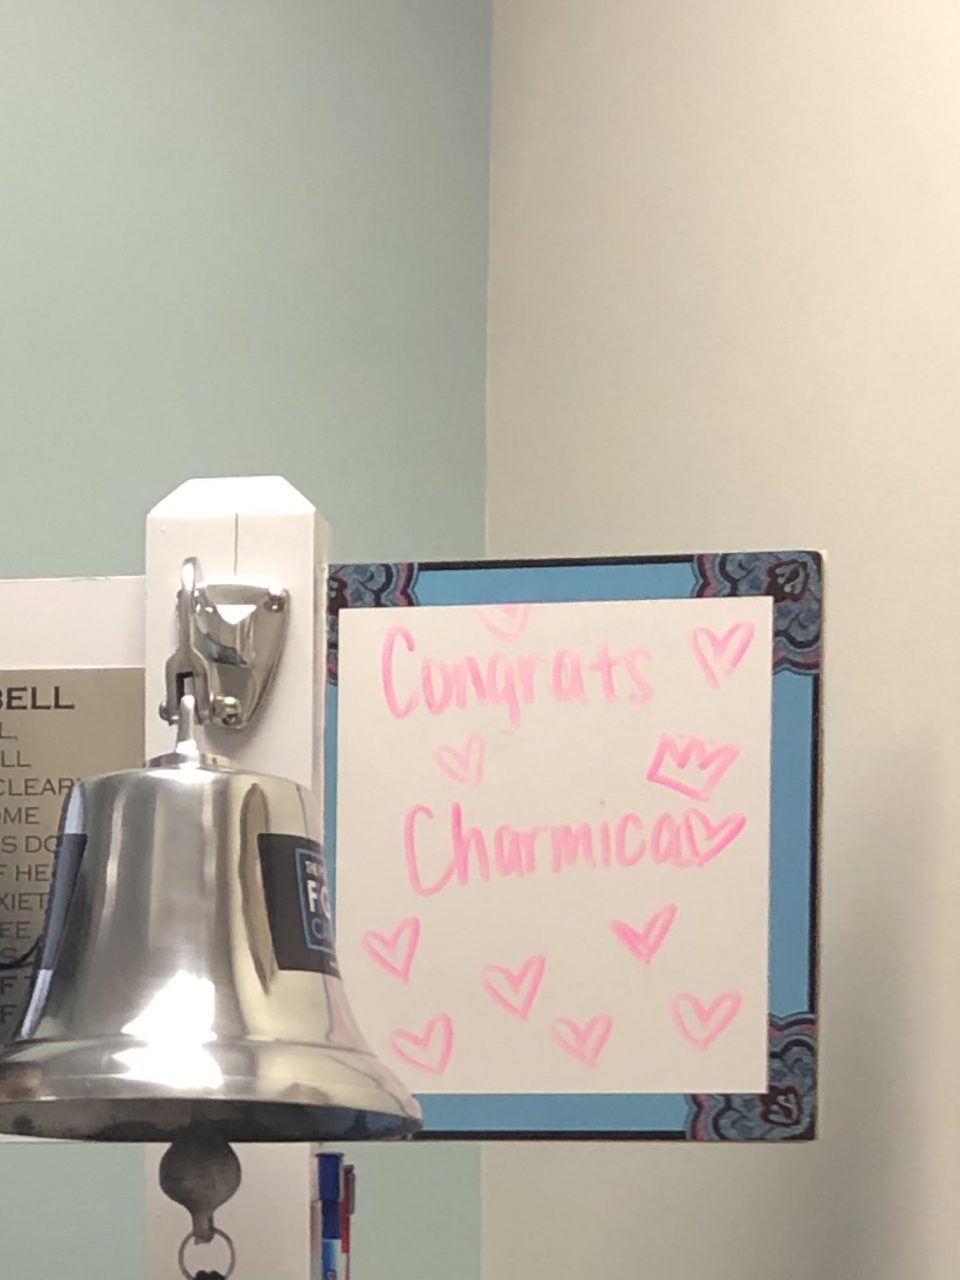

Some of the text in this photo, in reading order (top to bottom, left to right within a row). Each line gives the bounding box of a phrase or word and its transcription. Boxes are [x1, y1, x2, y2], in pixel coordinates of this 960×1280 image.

[381, 625, 653, 728] Congrats
[15, 864, 50, 882] HE
[404, 802, 706, 897] Charmica
